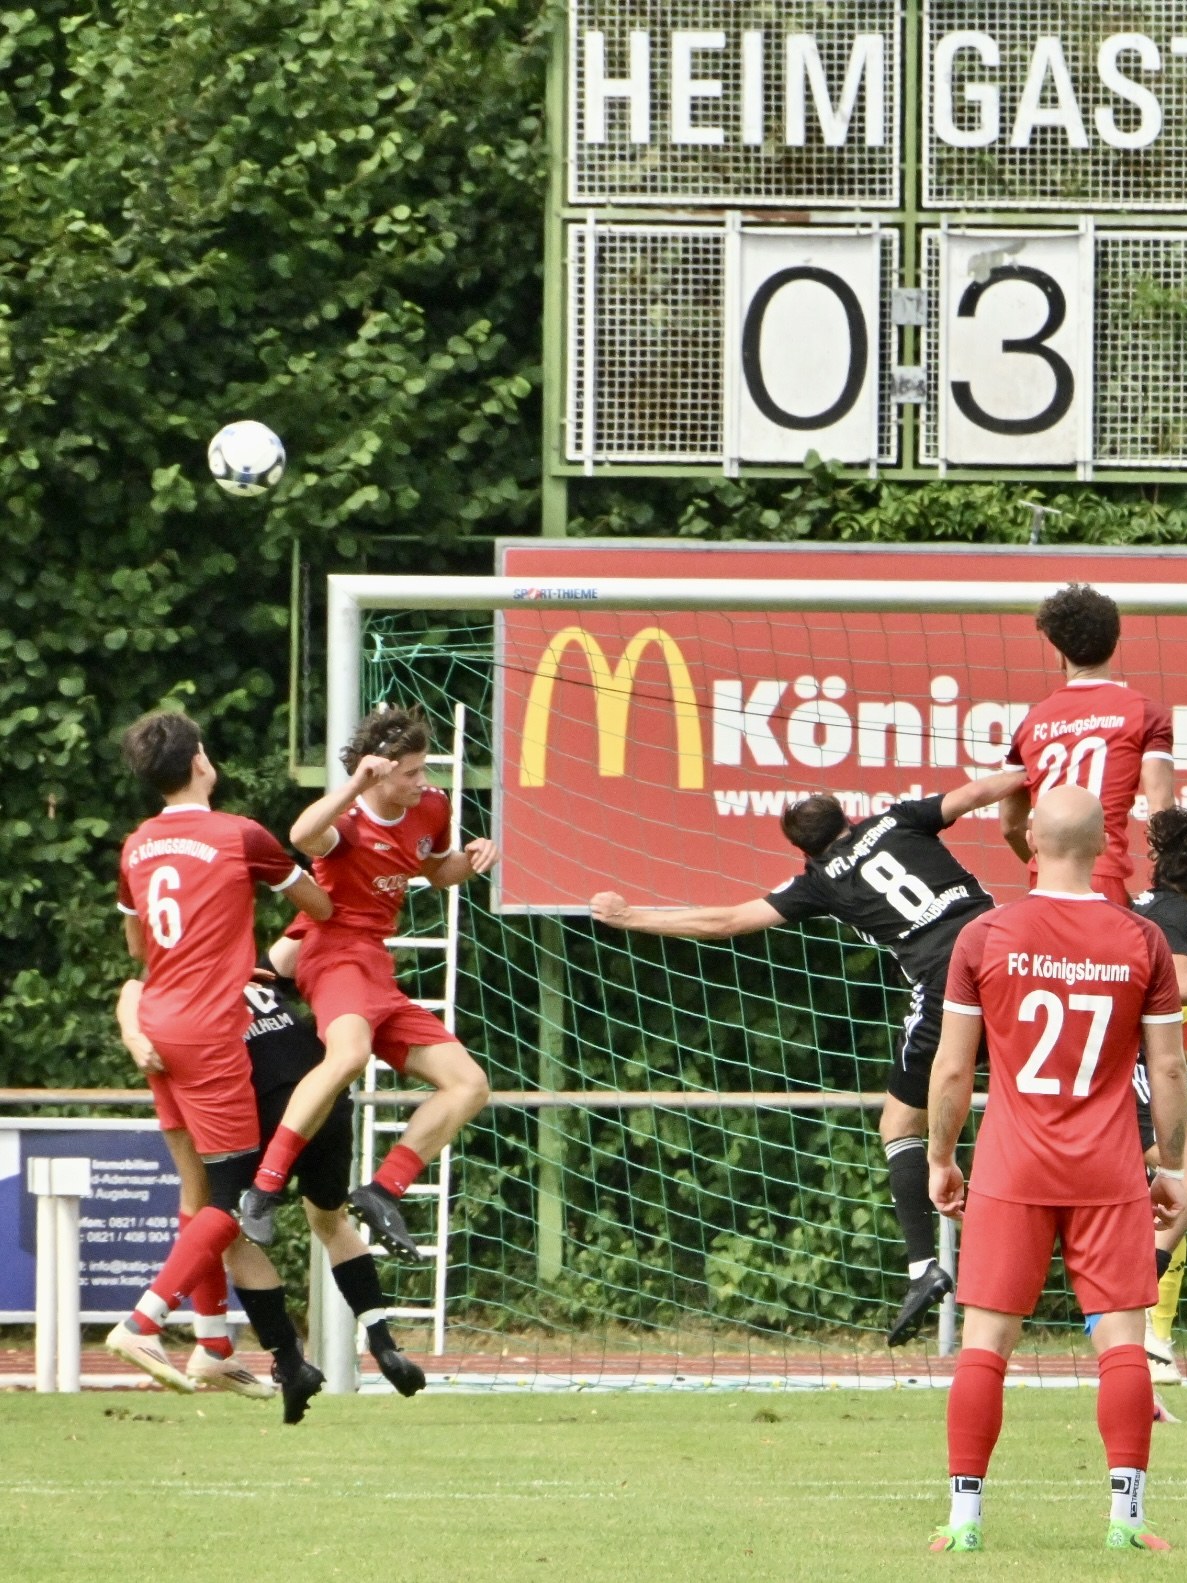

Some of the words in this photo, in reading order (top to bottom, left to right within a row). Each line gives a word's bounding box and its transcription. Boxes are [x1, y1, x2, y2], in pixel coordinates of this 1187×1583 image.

[584, 30, 885, 147] HEIM
[742, 266, 868, 431] 0
[950, 265, 1075, 435] 3
[513, 588, 599, 600] SPORT-THIEME
[1033, 722, 1048, 741] FC
[1037, 736, 1107, 801] 20
[148, 865, 182, 949] 6
[860, 850, 937, 923] 8
[1008, 953, 1029, 976] FC
[1033, 954, 1130, 985] Königsbrunn
[1016, 989, 1114, 1097] 27
